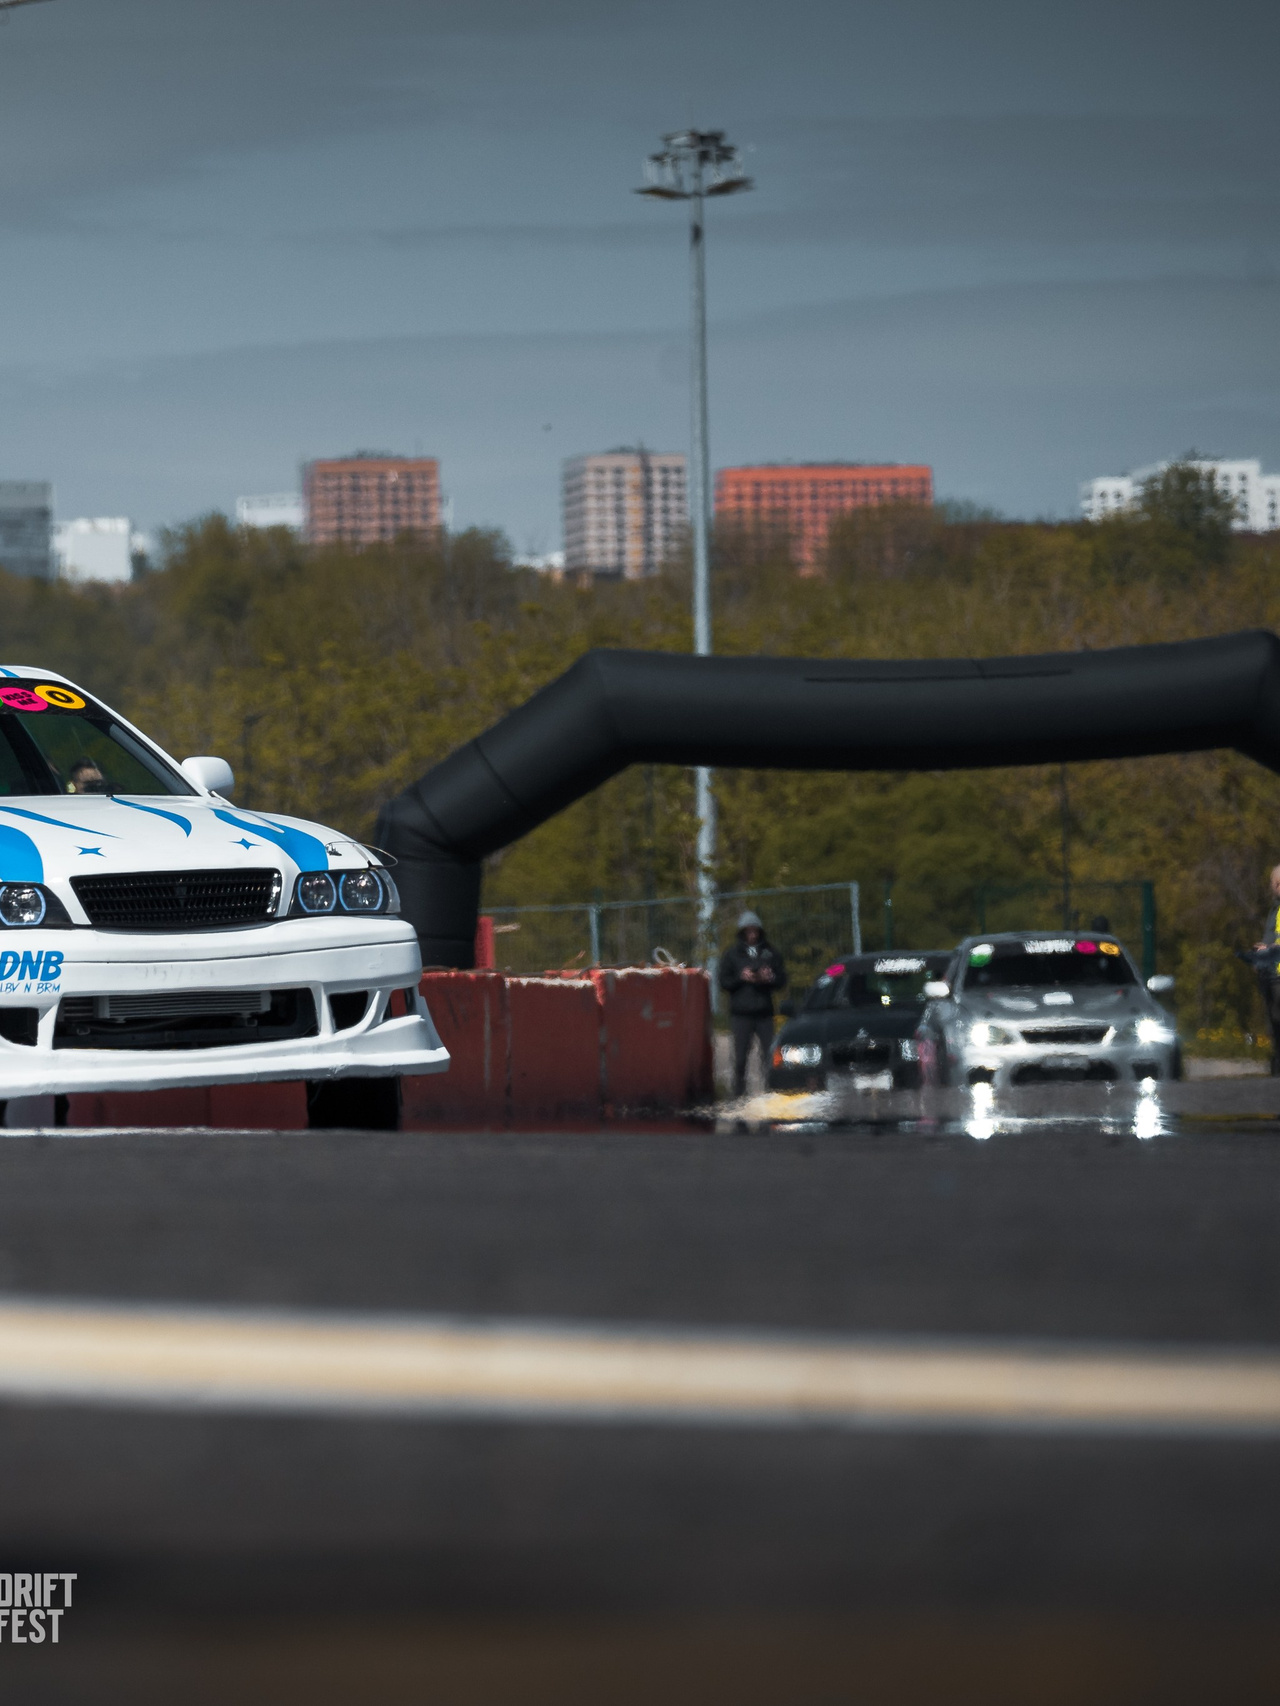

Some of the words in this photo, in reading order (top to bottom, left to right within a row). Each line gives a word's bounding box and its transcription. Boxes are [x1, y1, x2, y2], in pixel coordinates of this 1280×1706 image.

[2, 691, 33, 701] KISS
[17, 698, 39, 706] ME
[24, 983, 33, 993] N
[36, 982, 61, 994] BRM
